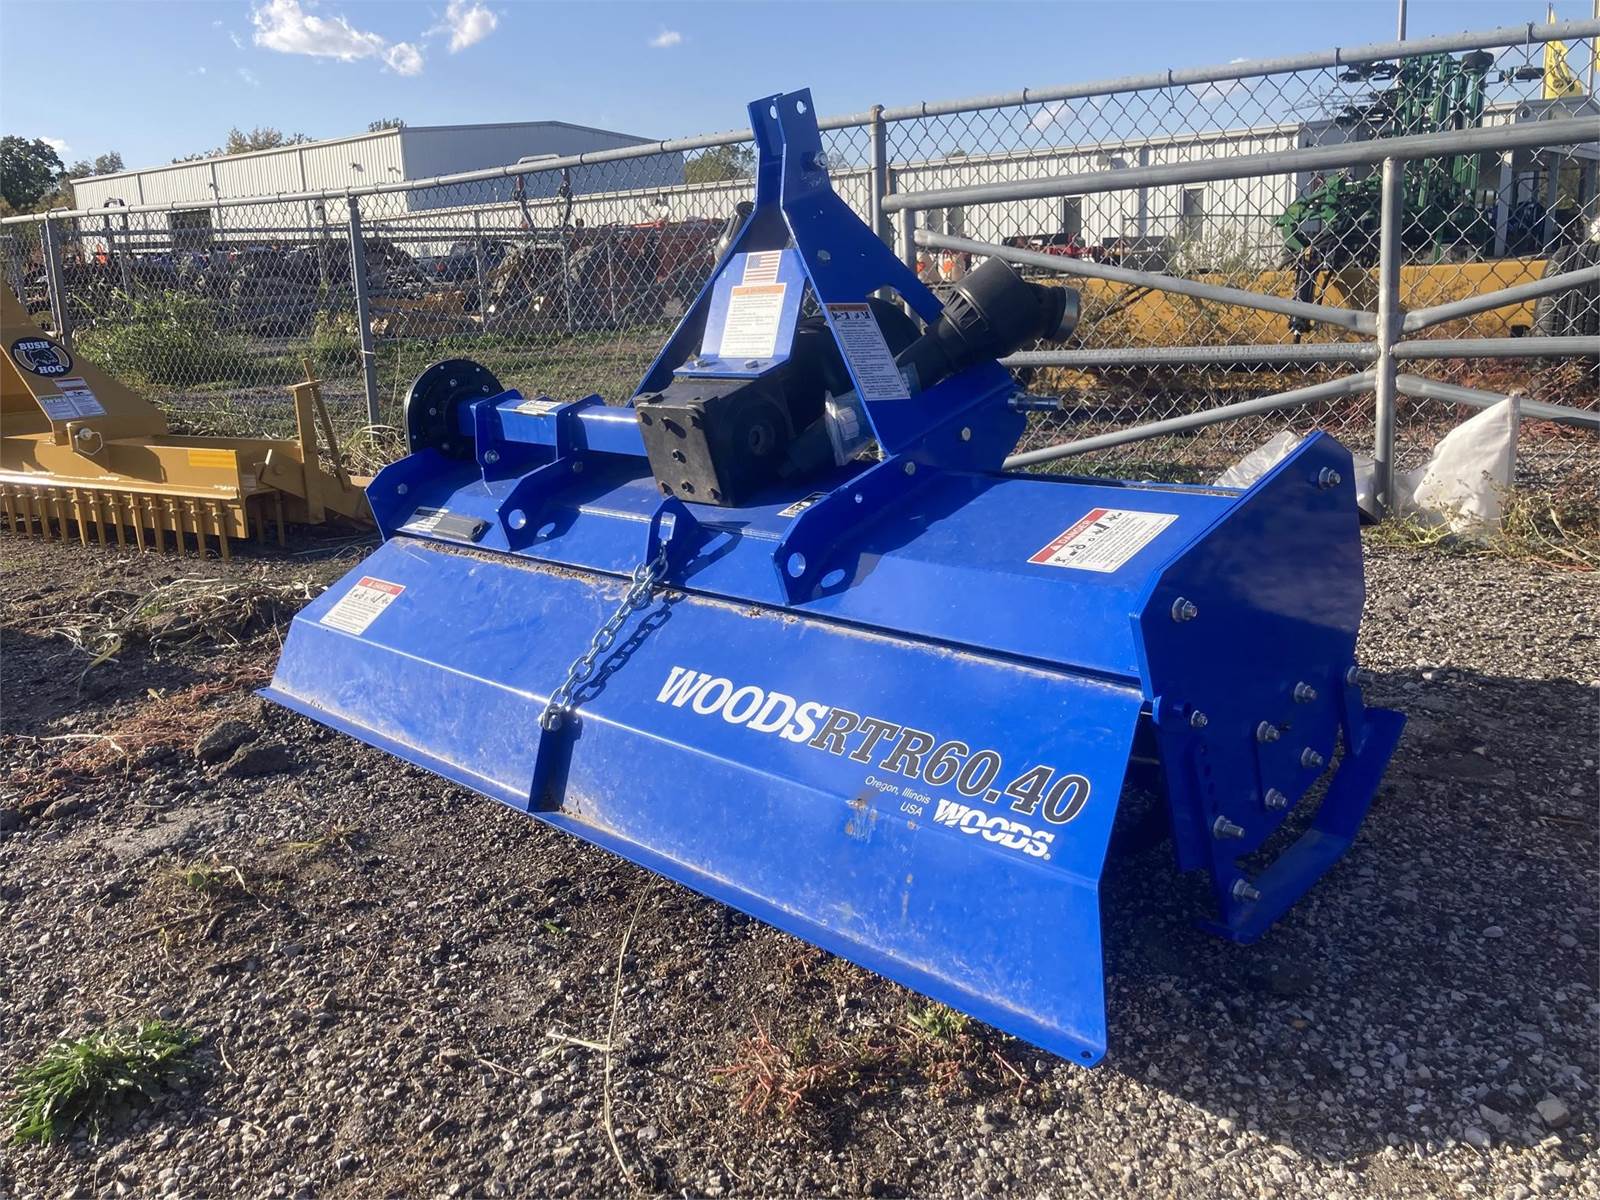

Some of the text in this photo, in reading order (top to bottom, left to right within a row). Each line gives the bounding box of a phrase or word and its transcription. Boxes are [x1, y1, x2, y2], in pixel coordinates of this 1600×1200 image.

[18, 341, 50, 351] BUSH
[38, 365, 64, 374] HOG
[865, 775, 932, 804] Oregon, Illinois
[900, 801, 924, 817] USA
